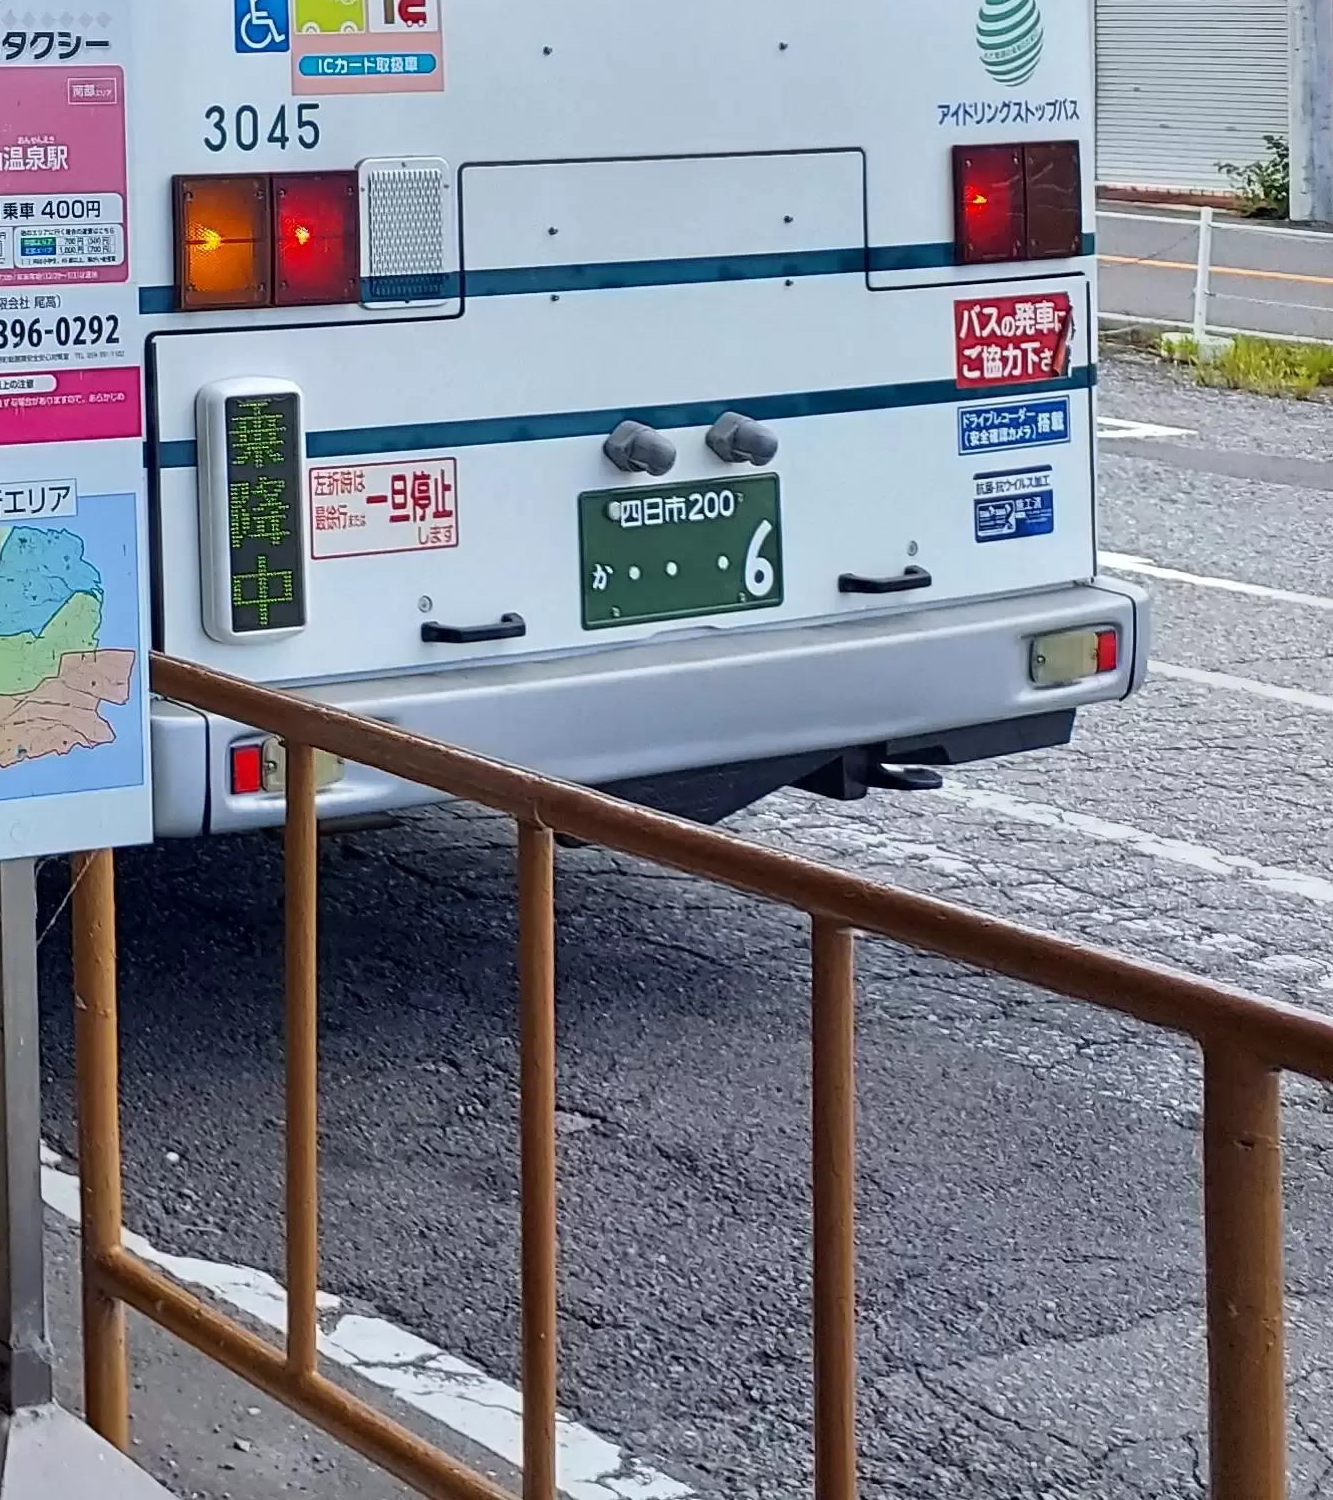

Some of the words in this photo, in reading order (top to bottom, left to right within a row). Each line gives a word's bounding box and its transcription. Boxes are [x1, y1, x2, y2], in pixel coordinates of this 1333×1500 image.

[318, 56, 418, 75] ICカード取扱車
[937, 97, 1080, 128] アイドリングストップバス
[204, 103, 320, 152] 3045
[41, 199, 101, 219] 400円
[960, 300, 1067, 340] バスの発車に
[963, 408, 1036, 427] ドライブレコーダー
[1037, 411, 1064, 433] 搭載
[314, 469, 366, 496] 左折時は
[366, 468, 453, 523] 一旦停止
[231, 399, 293, 626] 乗降中
[417, 524, 454, 545] します
[592, 562, 613, 591] か
